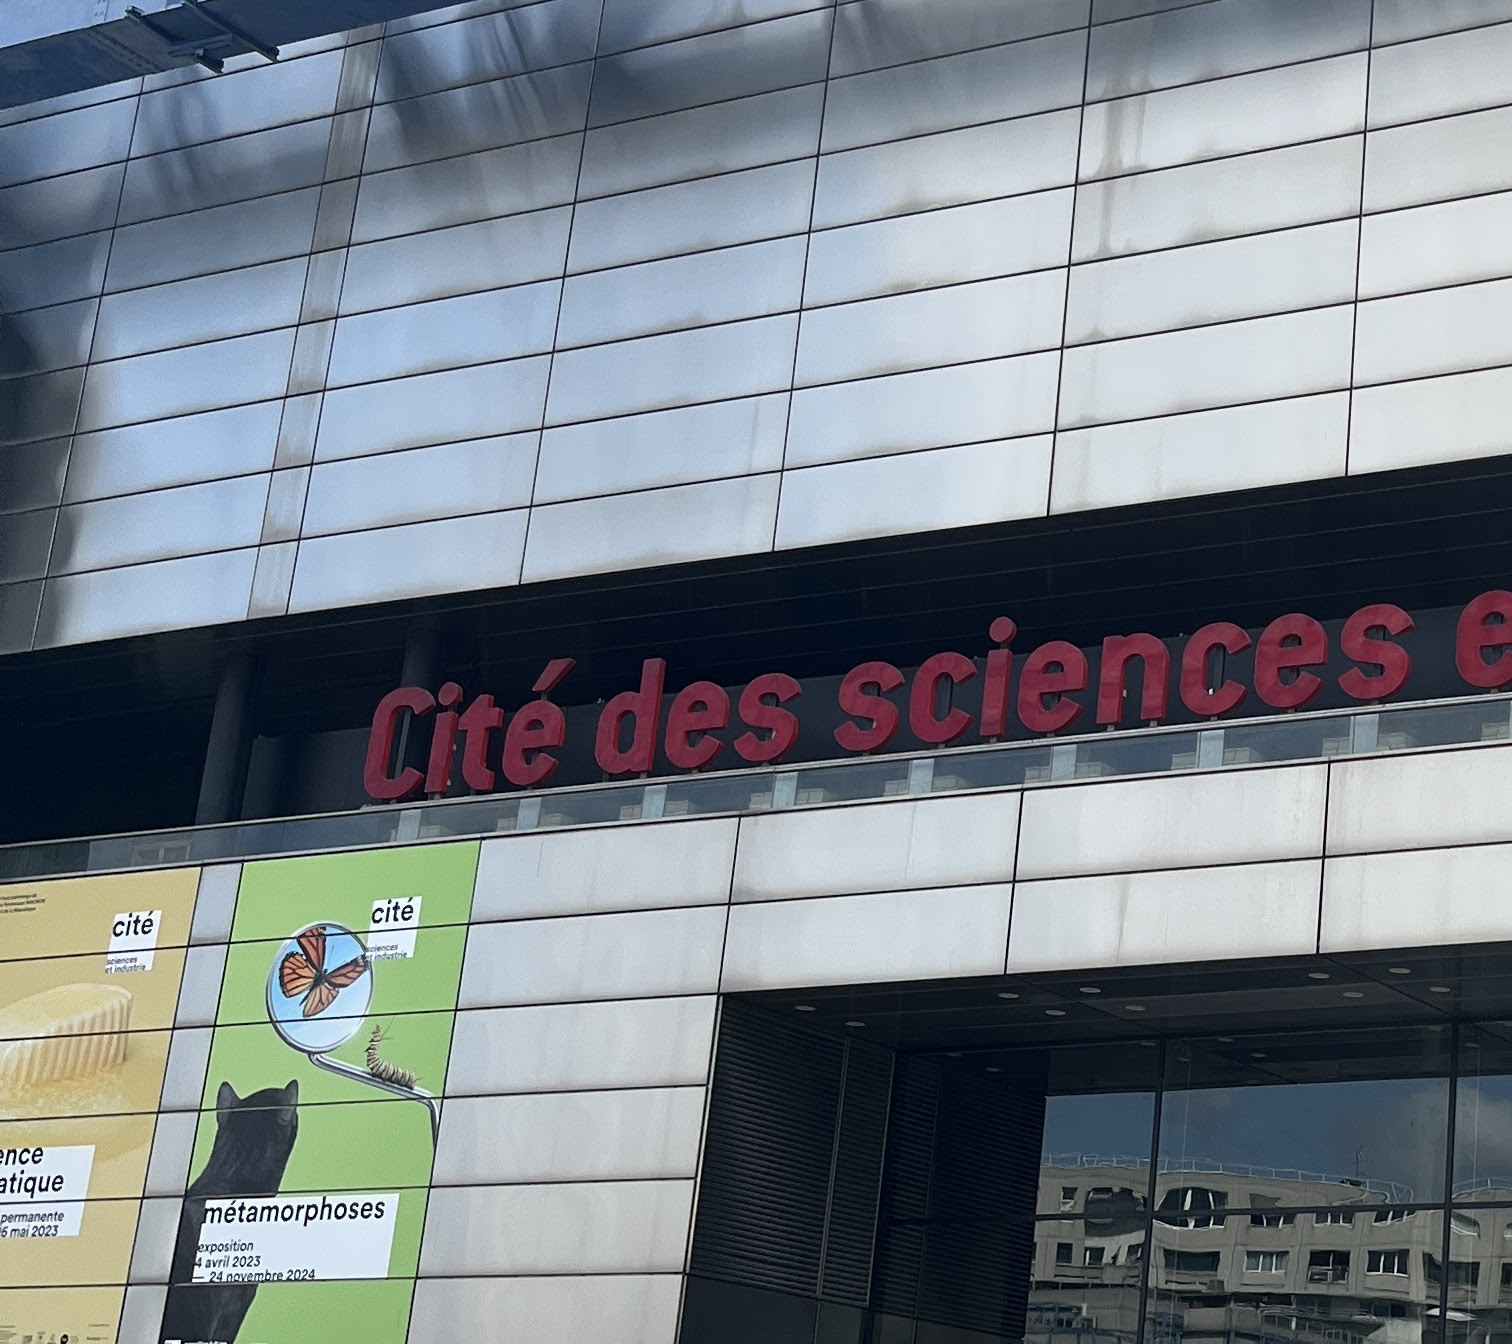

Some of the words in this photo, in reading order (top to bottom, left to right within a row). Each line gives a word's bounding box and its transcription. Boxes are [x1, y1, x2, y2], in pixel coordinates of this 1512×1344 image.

[363, 658, 577, 799] Cité
[594, 658, 803, 774] des
[833, 616, 1415, 753] sciences
[371, 896, 414, 924] cité
[112, 909, 155, 938] cité
[1, 1211, 65, 1224] permanente
[201, 1195, 386, 1227] métamorphoses
[10, 1224, 31, 1238] mai
[31, 1224, 59, 1238] 2023
[197, 1239, 254, 1255] exposition
[204, 1256, 230, 1268] avril
[232, 1255, 262, 1268] 2023
[209, 1271, 223, 1283] 24
[226, 1269, 284, 1283] novembre
[285, 1269, 316, 1282] 2024
